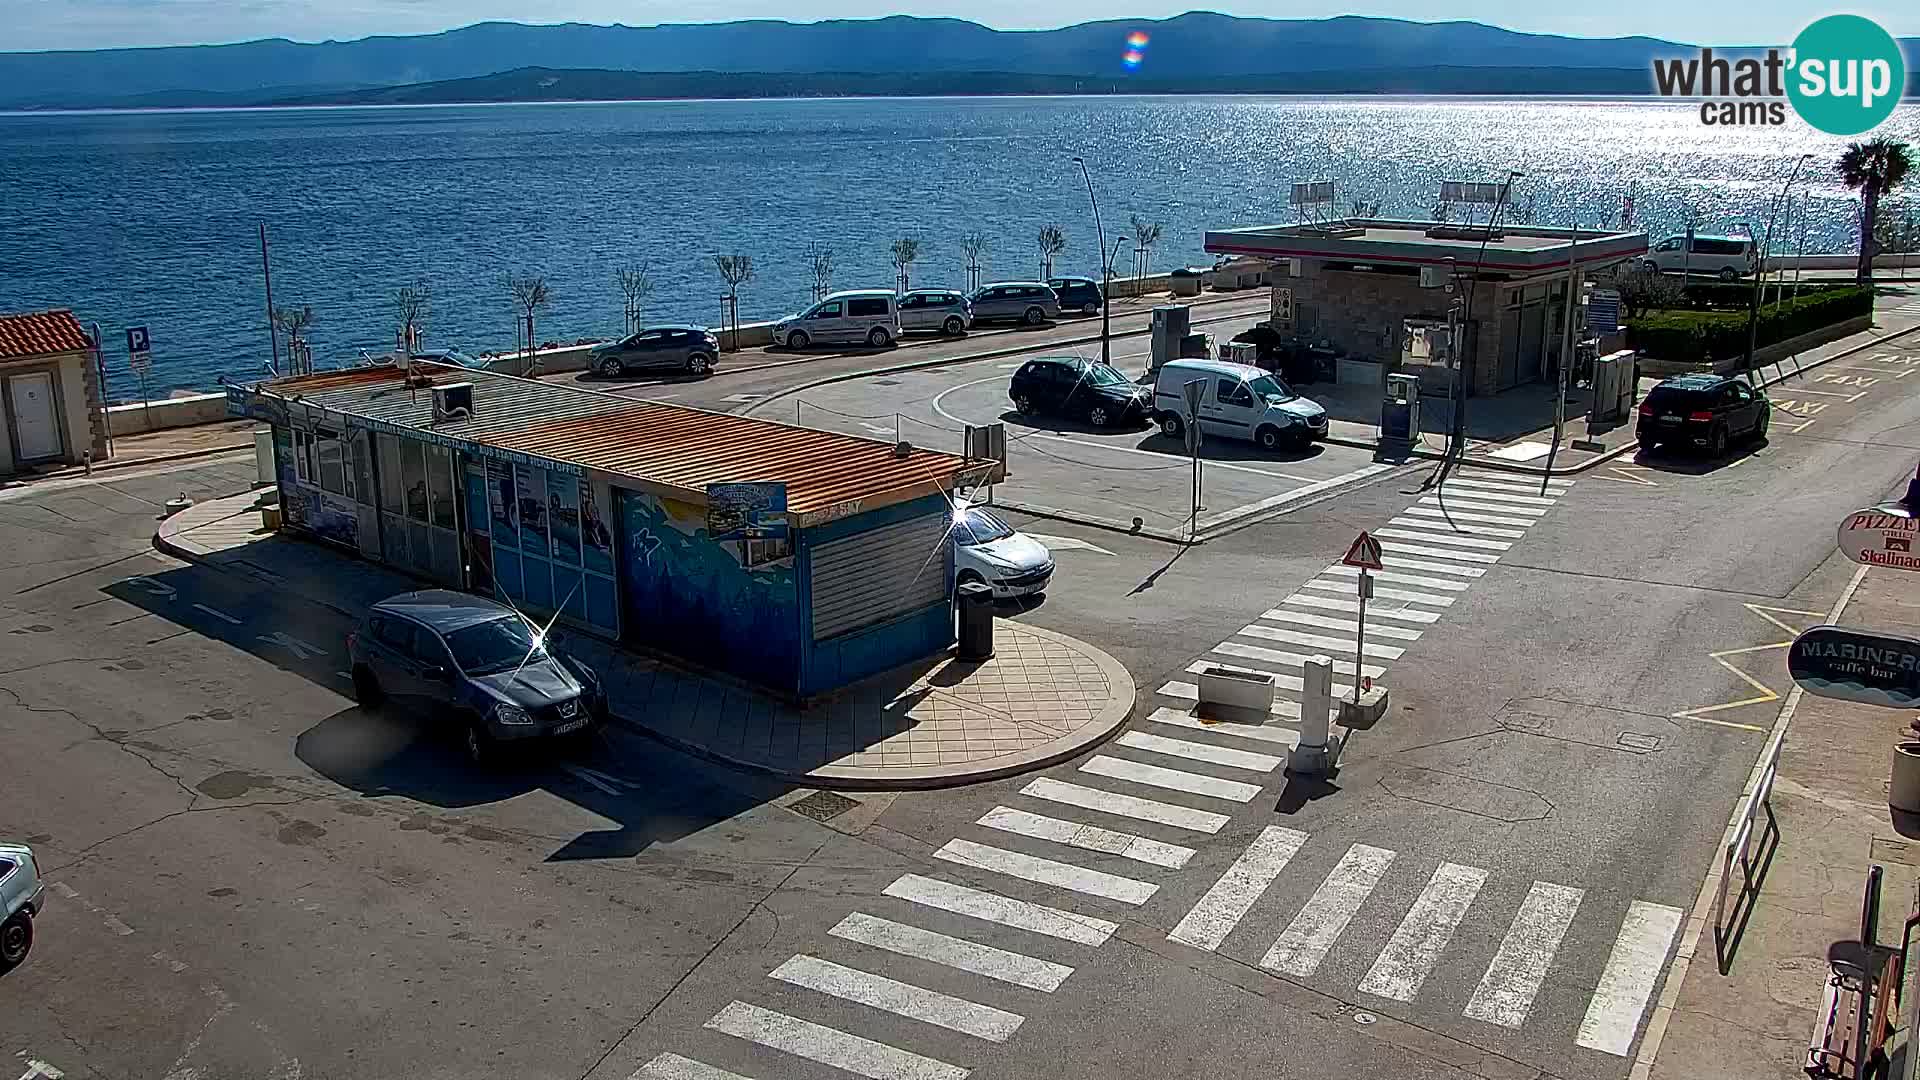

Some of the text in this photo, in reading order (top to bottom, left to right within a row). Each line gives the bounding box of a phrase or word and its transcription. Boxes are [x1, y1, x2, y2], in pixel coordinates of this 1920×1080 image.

[132, 331, 144, 348] P
[1815, 374, 1880, 388] TAXI
[495, 448, 527, 464] STATION
[555, 461, 584, 477] OFFICE
[1848, 514, 1920, 532] PIZZE
[1871, 665, 1897, 679] bar
